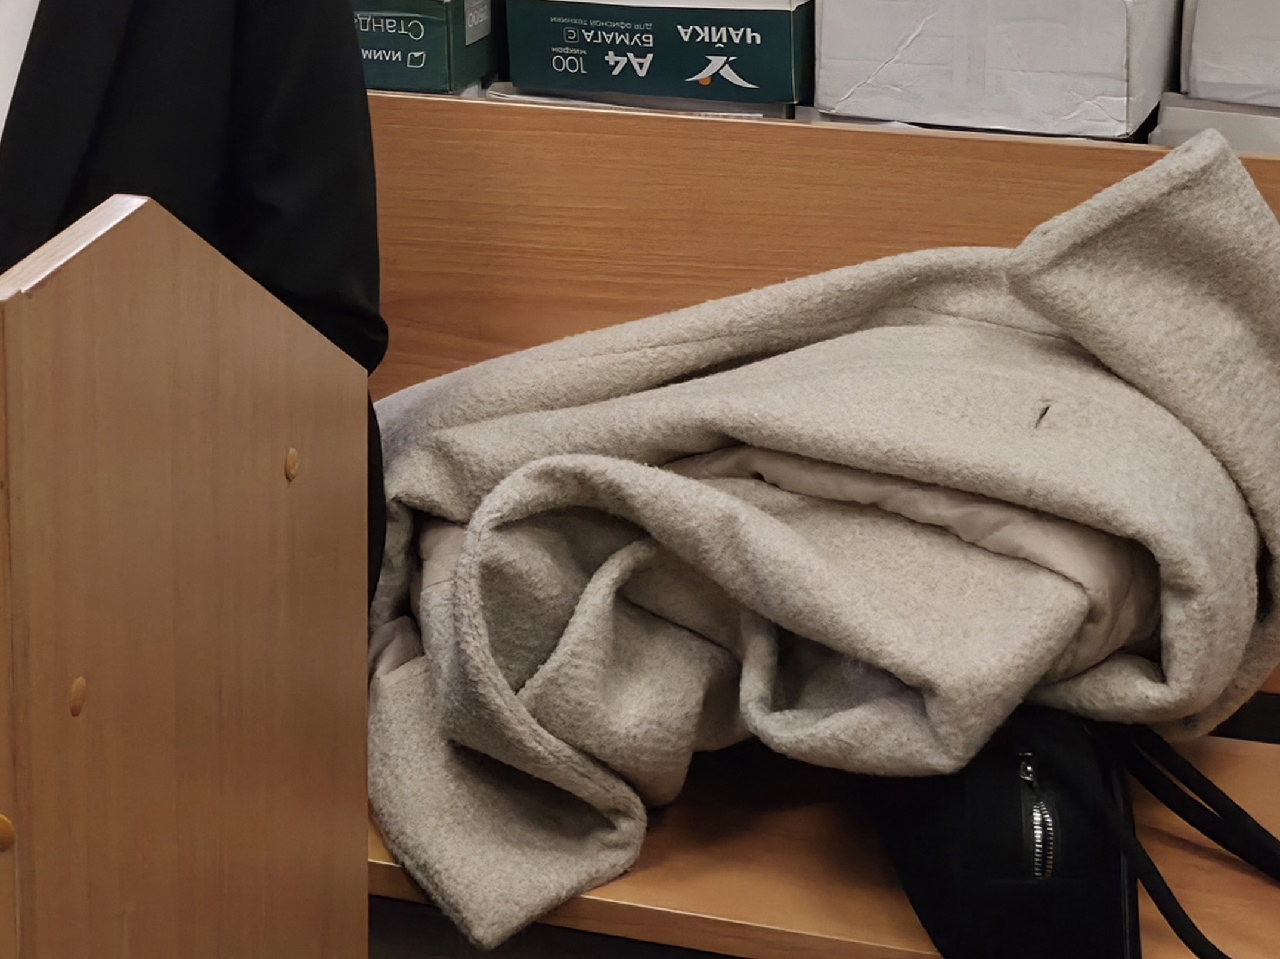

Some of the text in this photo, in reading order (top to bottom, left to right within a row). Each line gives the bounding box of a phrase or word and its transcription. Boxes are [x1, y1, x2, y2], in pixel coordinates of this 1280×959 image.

[354, 13, 425, 41] Станд
[581, 29, 654, 48] БУМАГА
[677, 25, 761, 48] ЧАЙКА
[552, 55, 587, 74] 100
[604, 50, 654, 77] A4
